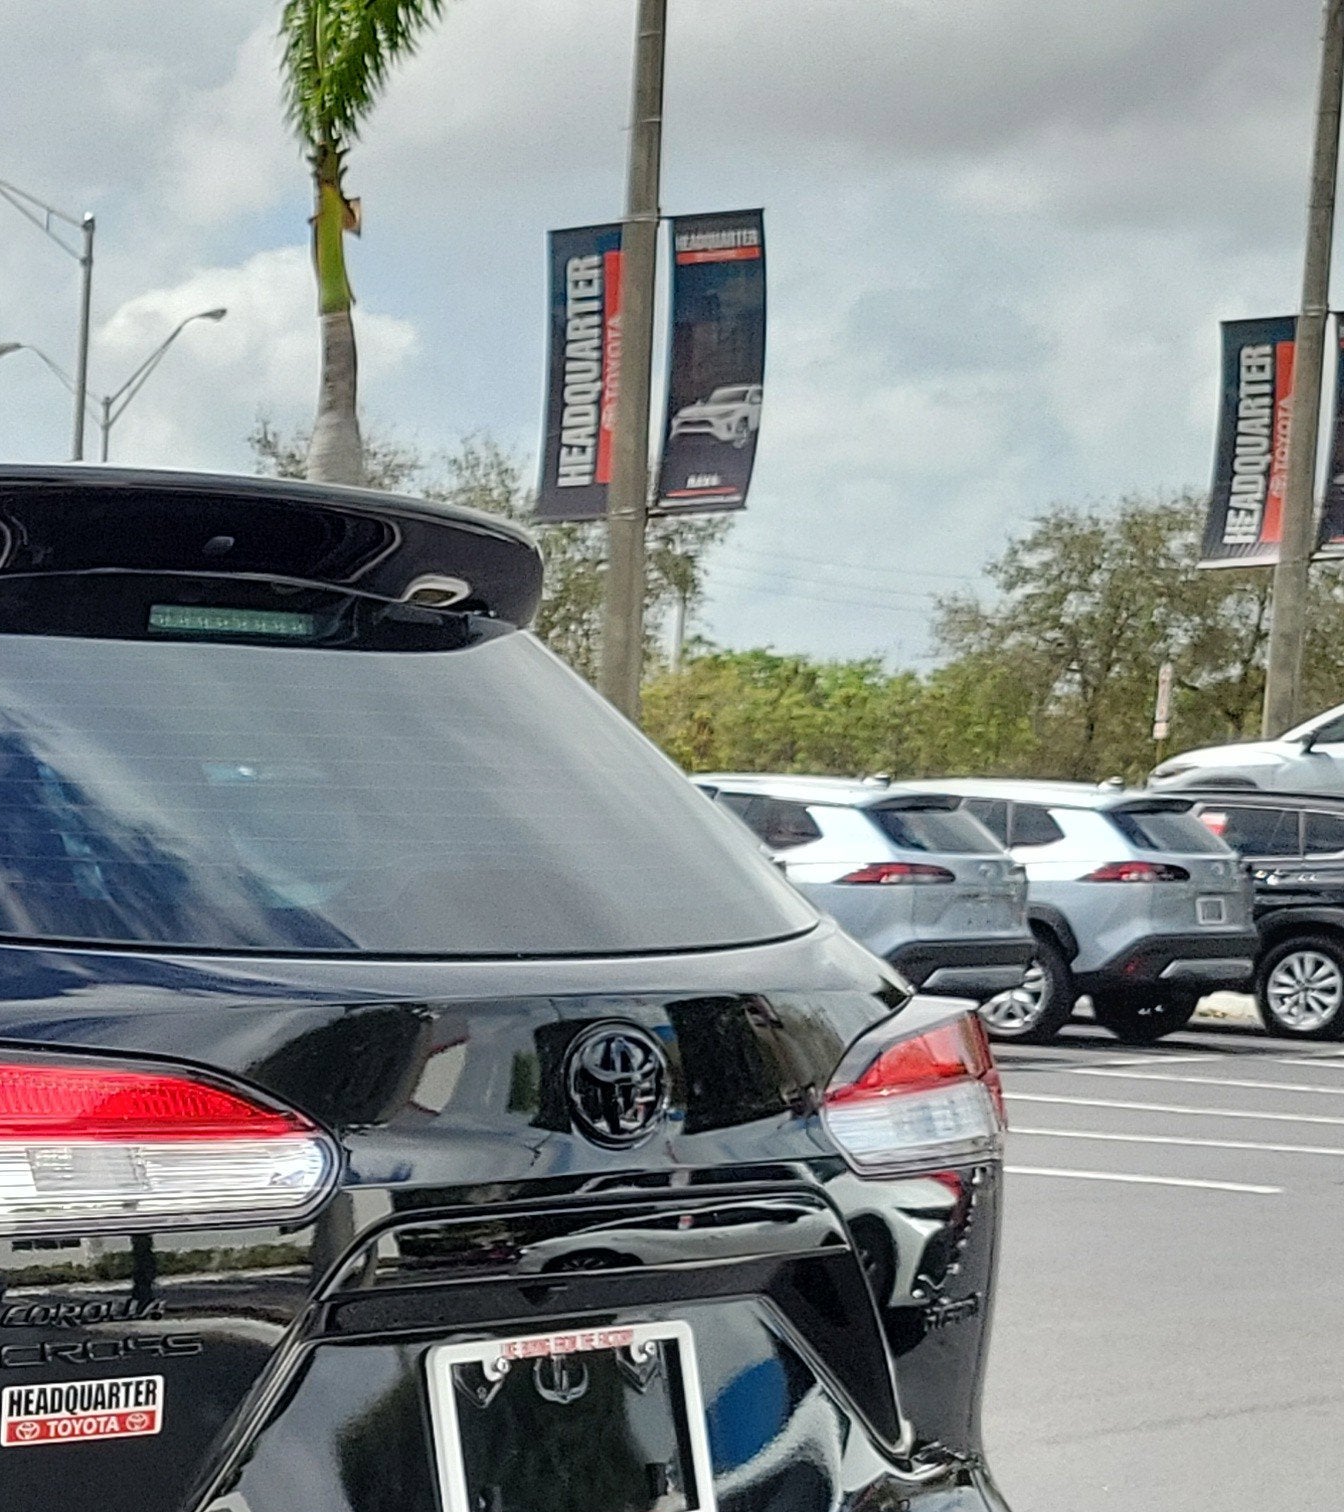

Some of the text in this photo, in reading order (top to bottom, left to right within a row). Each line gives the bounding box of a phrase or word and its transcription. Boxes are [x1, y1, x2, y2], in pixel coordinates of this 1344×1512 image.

[557, 254, 604, 487] HEADQUARTER
[1222, 344, 1274, 544] HEADQUARTER
[0, 1300, 167, 1328] COROLLA
[6, 1379, 158, 1418] HEADQUARTER
[46, 1416, 121, 1437] TOYOTA
